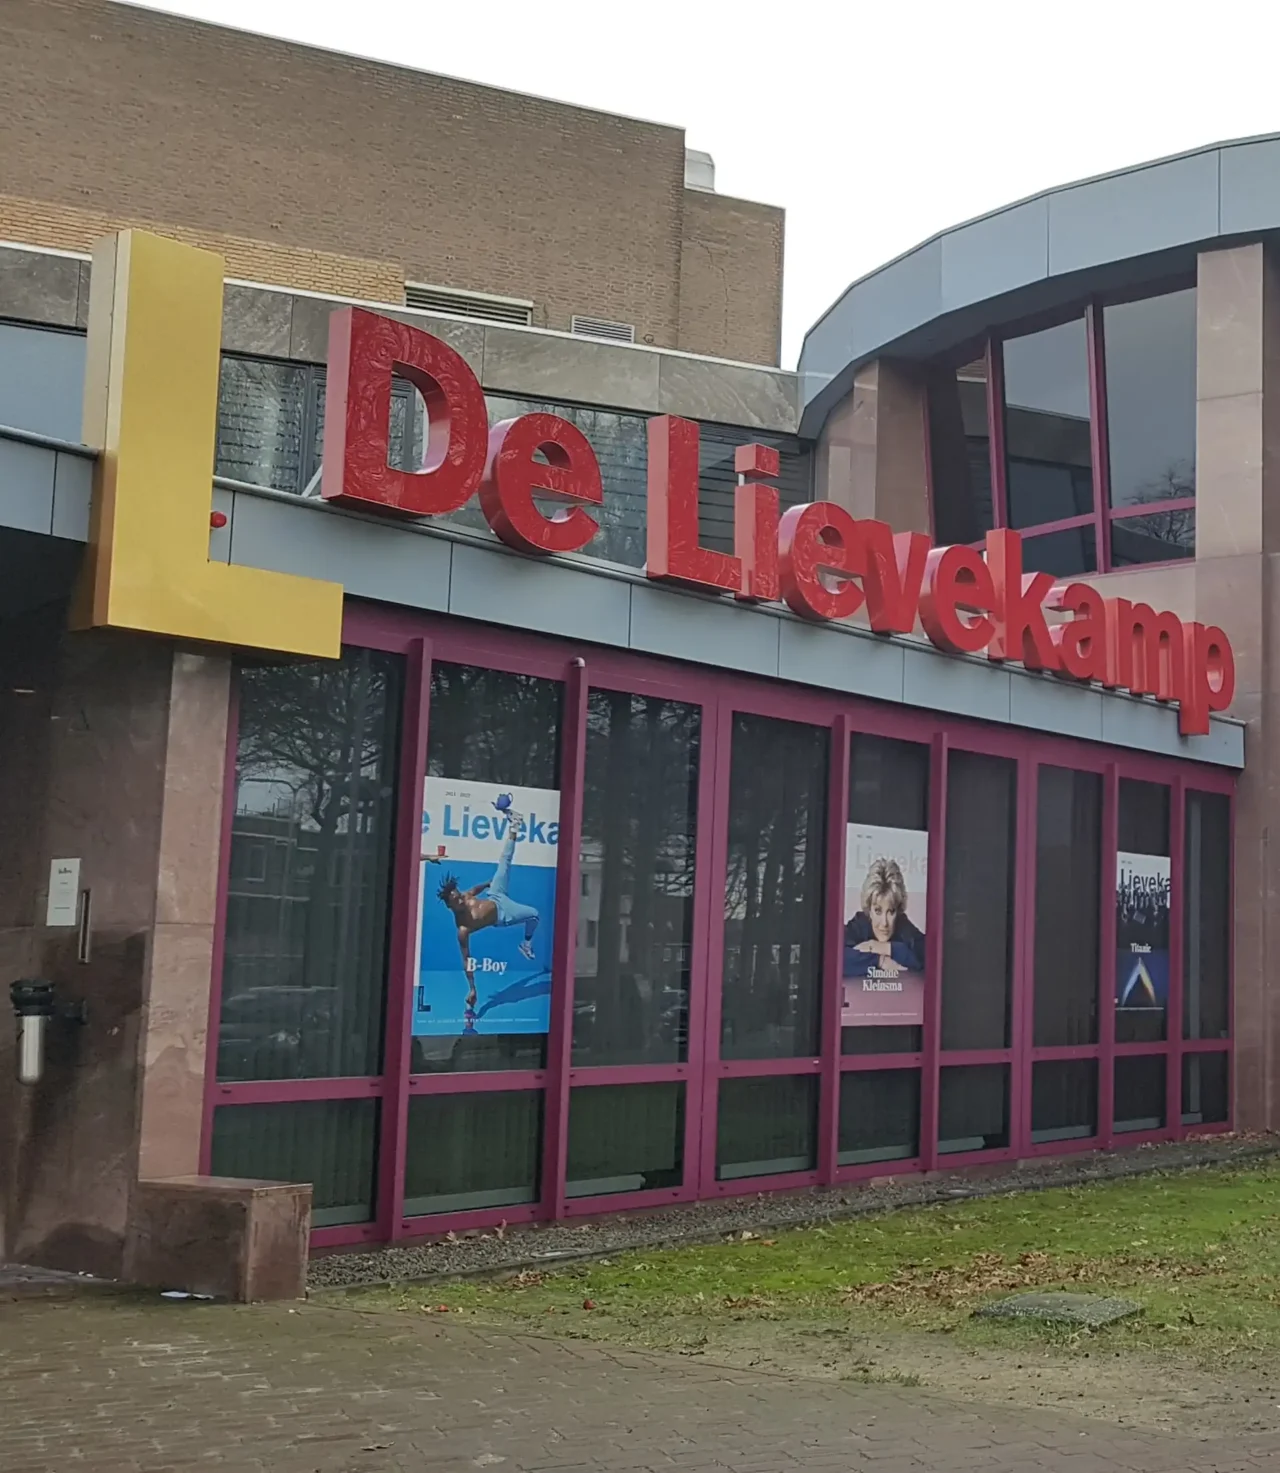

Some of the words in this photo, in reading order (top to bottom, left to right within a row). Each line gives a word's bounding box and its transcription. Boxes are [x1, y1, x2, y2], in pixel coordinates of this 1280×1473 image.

[83, 228, 344, 659] L
[321, 305, 604, 555] De
[646, 414, 1236, 736] Lievekamp
[466, 957, 508, 975] B-Boy
[863, 979, 903, 992] Kleinsma
